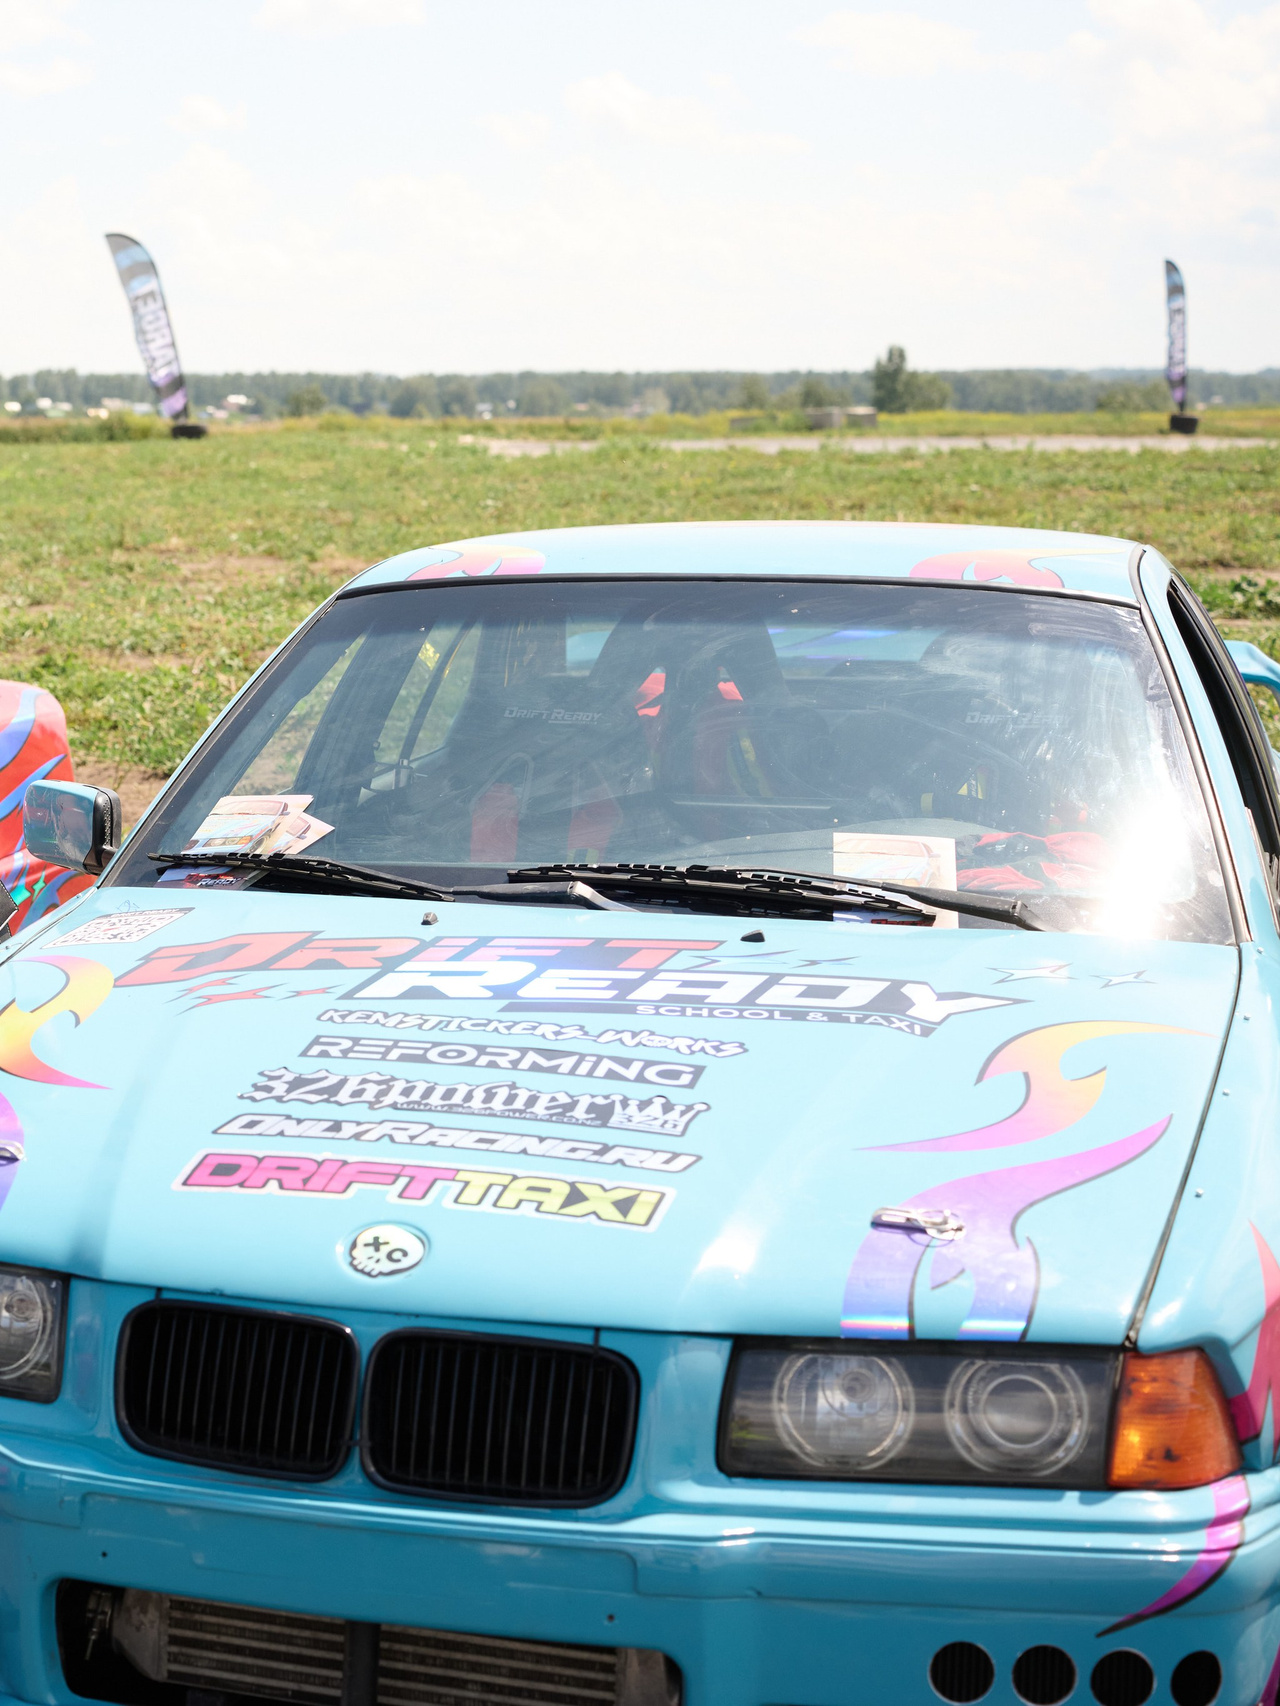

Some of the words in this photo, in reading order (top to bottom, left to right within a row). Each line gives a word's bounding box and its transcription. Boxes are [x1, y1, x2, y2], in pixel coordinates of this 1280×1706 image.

[504, 707, 551, 719] DRIFT
[551, 709, 602, 721] READY
[114, 931, 723, 987] DRIFT
[353, 961, 1015, 1024] READY
[635, 1004, 792, 1021] SCHOOL
[806, 1011, 829, 1022] &
[842, 1013, 921, 1035] TAXI
